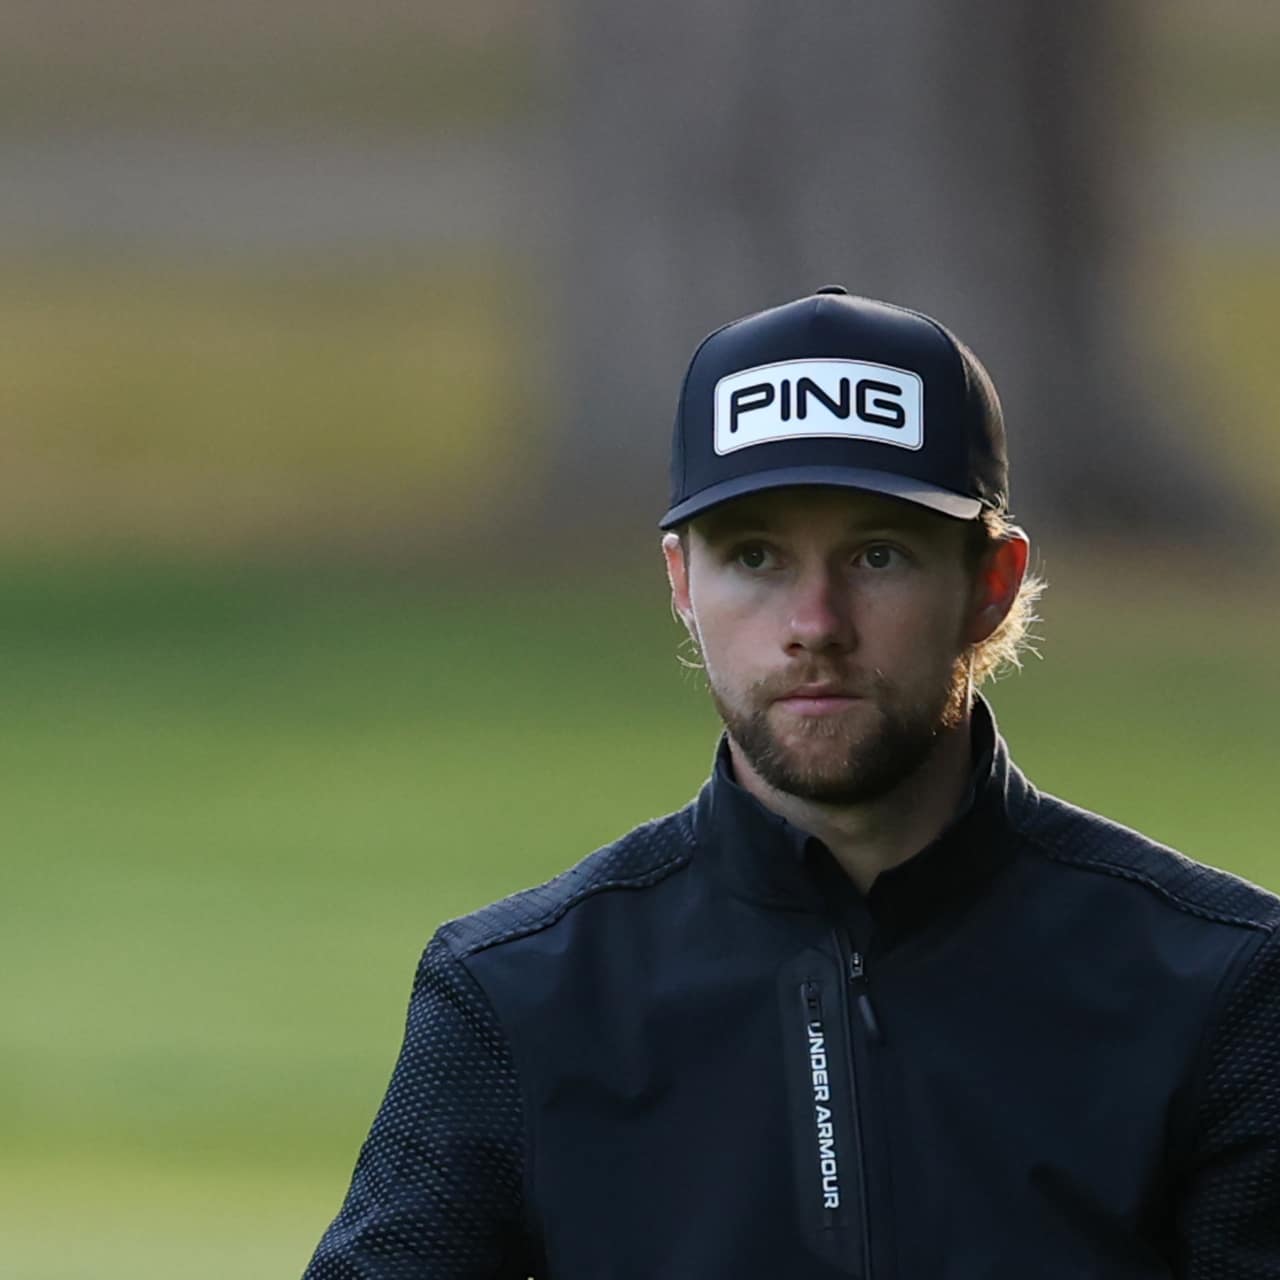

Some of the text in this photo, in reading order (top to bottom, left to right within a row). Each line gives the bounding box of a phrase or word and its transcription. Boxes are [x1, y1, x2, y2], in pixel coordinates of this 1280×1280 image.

[730, 376, 906, 434] PING
[807, 1022, 840, 1209] UNDER ARMOUR
